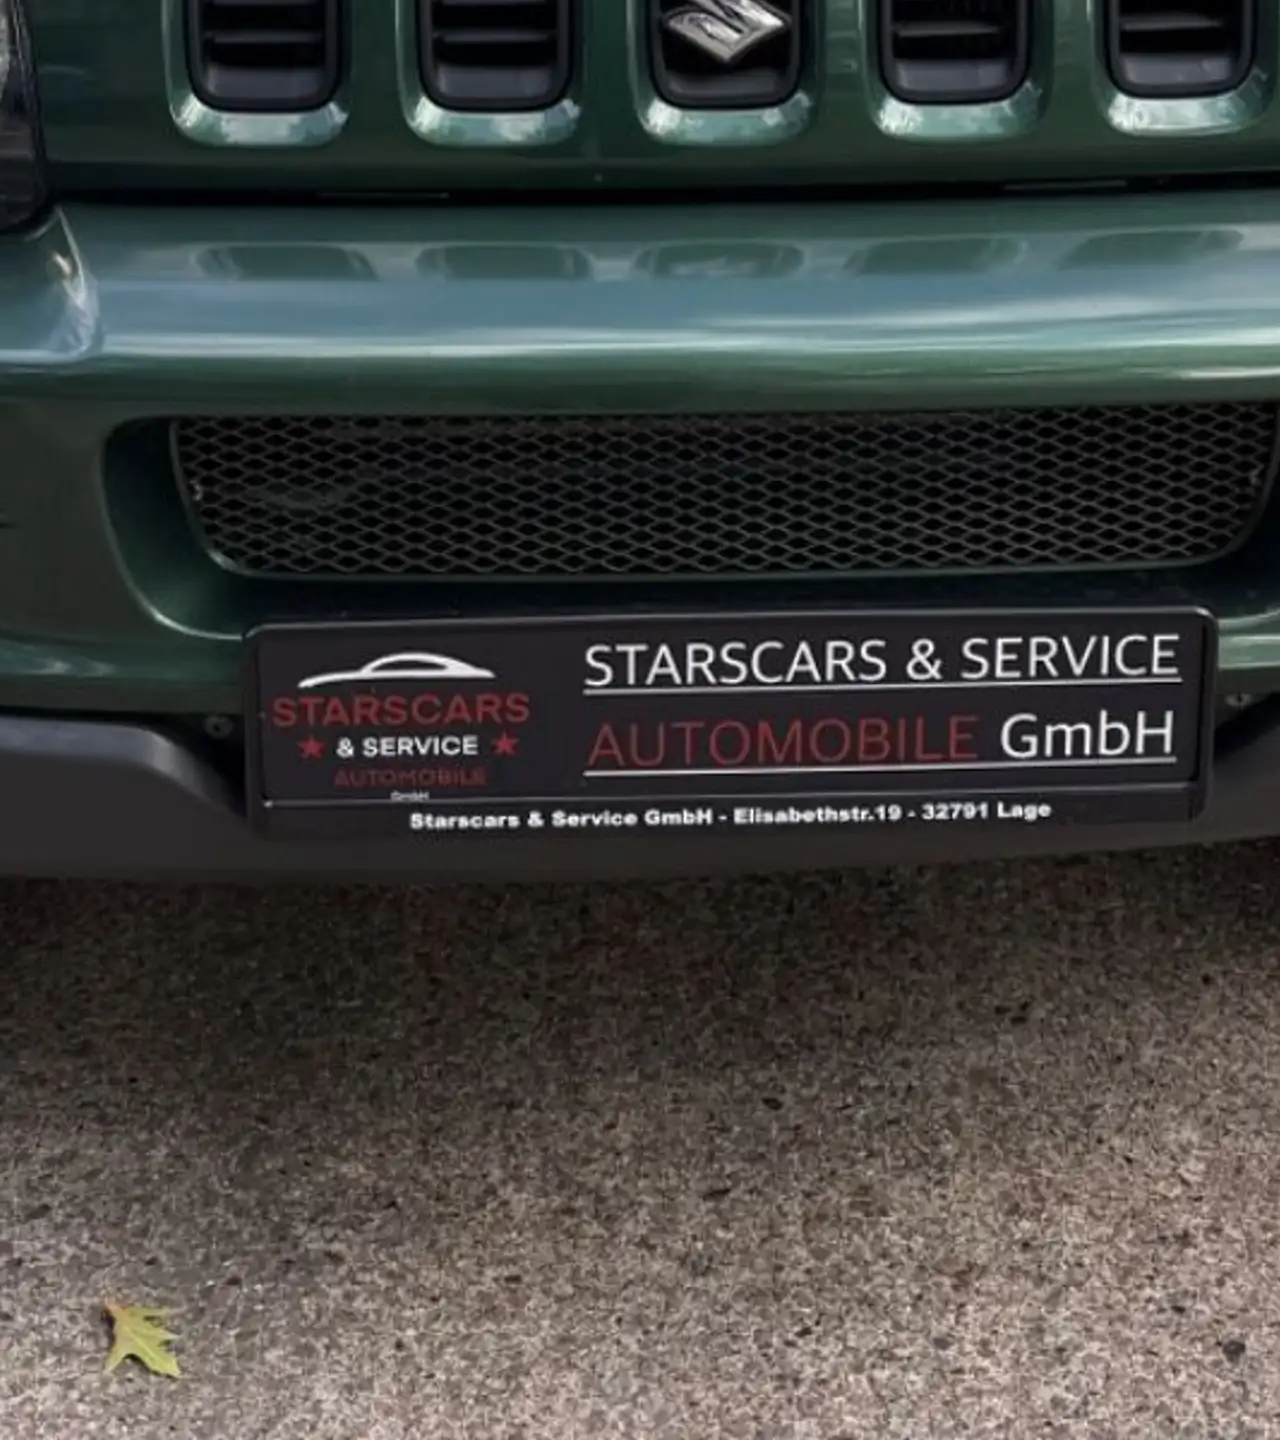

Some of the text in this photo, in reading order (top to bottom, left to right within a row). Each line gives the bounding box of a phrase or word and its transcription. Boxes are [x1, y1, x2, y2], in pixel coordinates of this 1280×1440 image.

[583, 633, 1181, 686] STARSCARS & SERVICE
[272, 692, 531, 727] STARSCARS
[336, 734, 479, 758] & SERVICE
[588, 709, 1175, 767] AUTOMOBILE GmbH
[333, 768, 489, 788] AUTOMOBILE
[410, 812, 521, 830] Starscars
[527, 811, 545, 828] &
[551, 810, 638, 828] Service
[644, 808, 713, 826] GmbH
[733, 804, 903, 825] Elisabethstr.19
[922, 802, 988, 821] 32791
[996, 801, 1052, 822] Lage
